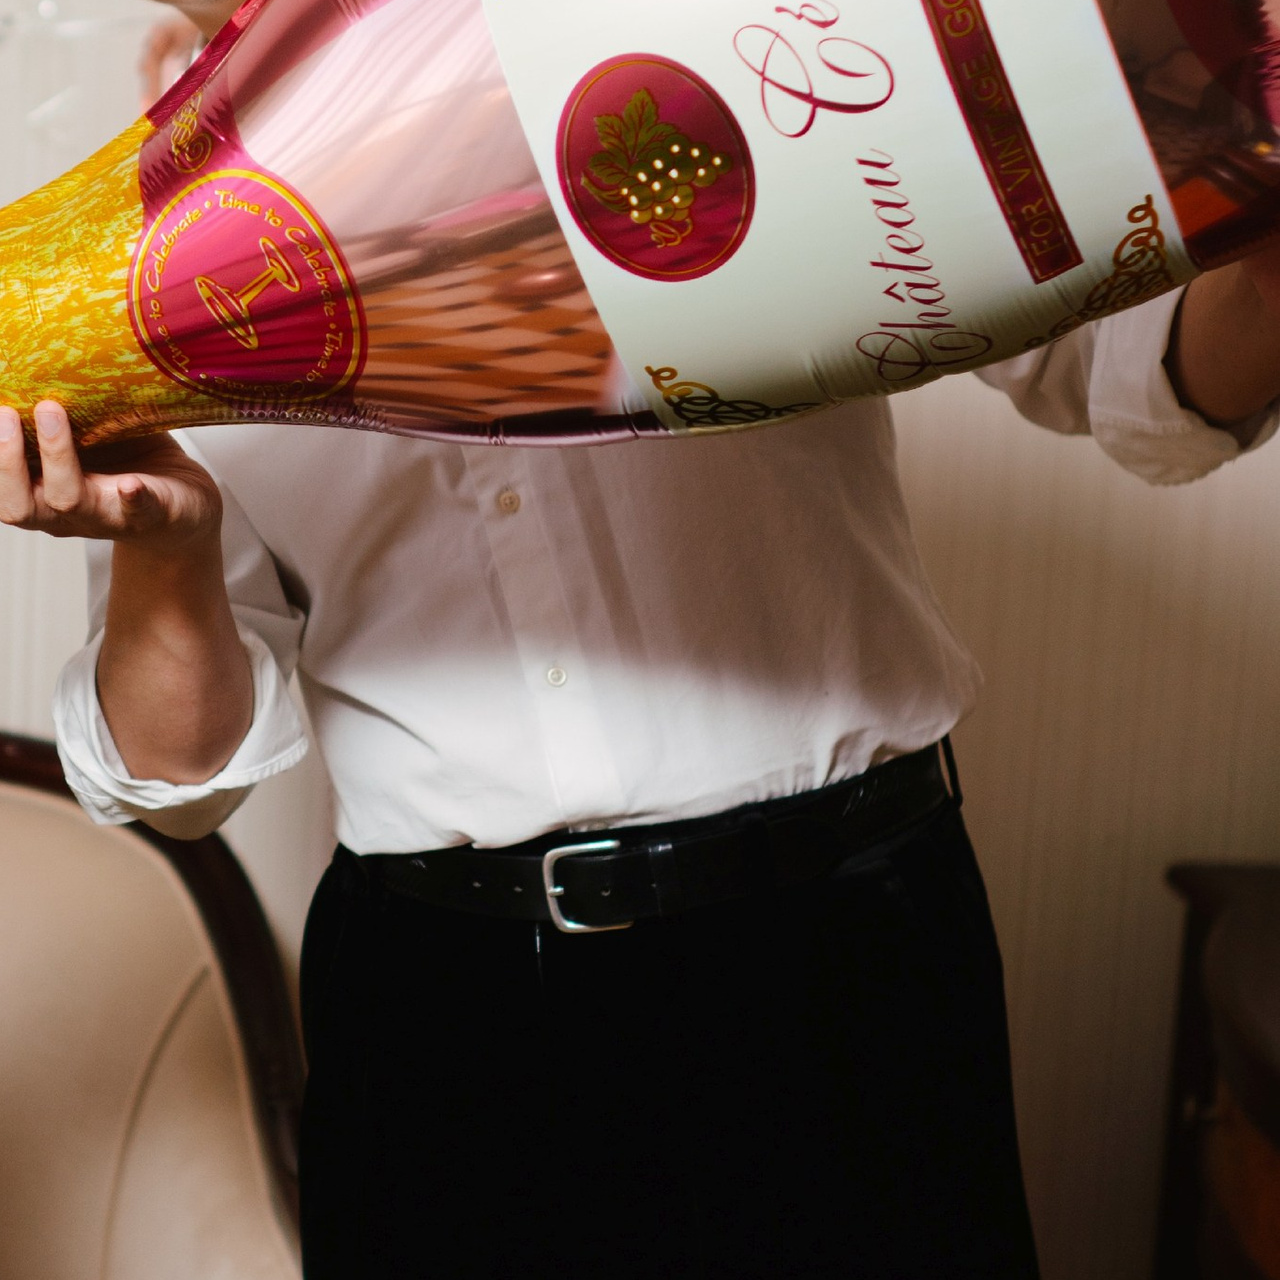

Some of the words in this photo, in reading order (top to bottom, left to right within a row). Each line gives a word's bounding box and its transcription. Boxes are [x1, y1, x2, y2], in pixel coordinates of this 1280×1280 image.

[962, 54, 1032, 193] VINTAGE
[146, 208, 202, 293] Celebrate
[214, 189, 261, 216] Time
[264, 208, 284, 228] to
[285, 226, 337, 317] Celebrate
[1022, 198, 1062, 258] FOR
[855, 148, 993, 381] Château
[149, 299, 163, 321] to
[158, 324, 191, 373] Time
[306, 367, 325, 383] to
[317, 331, 344, 369] Time
